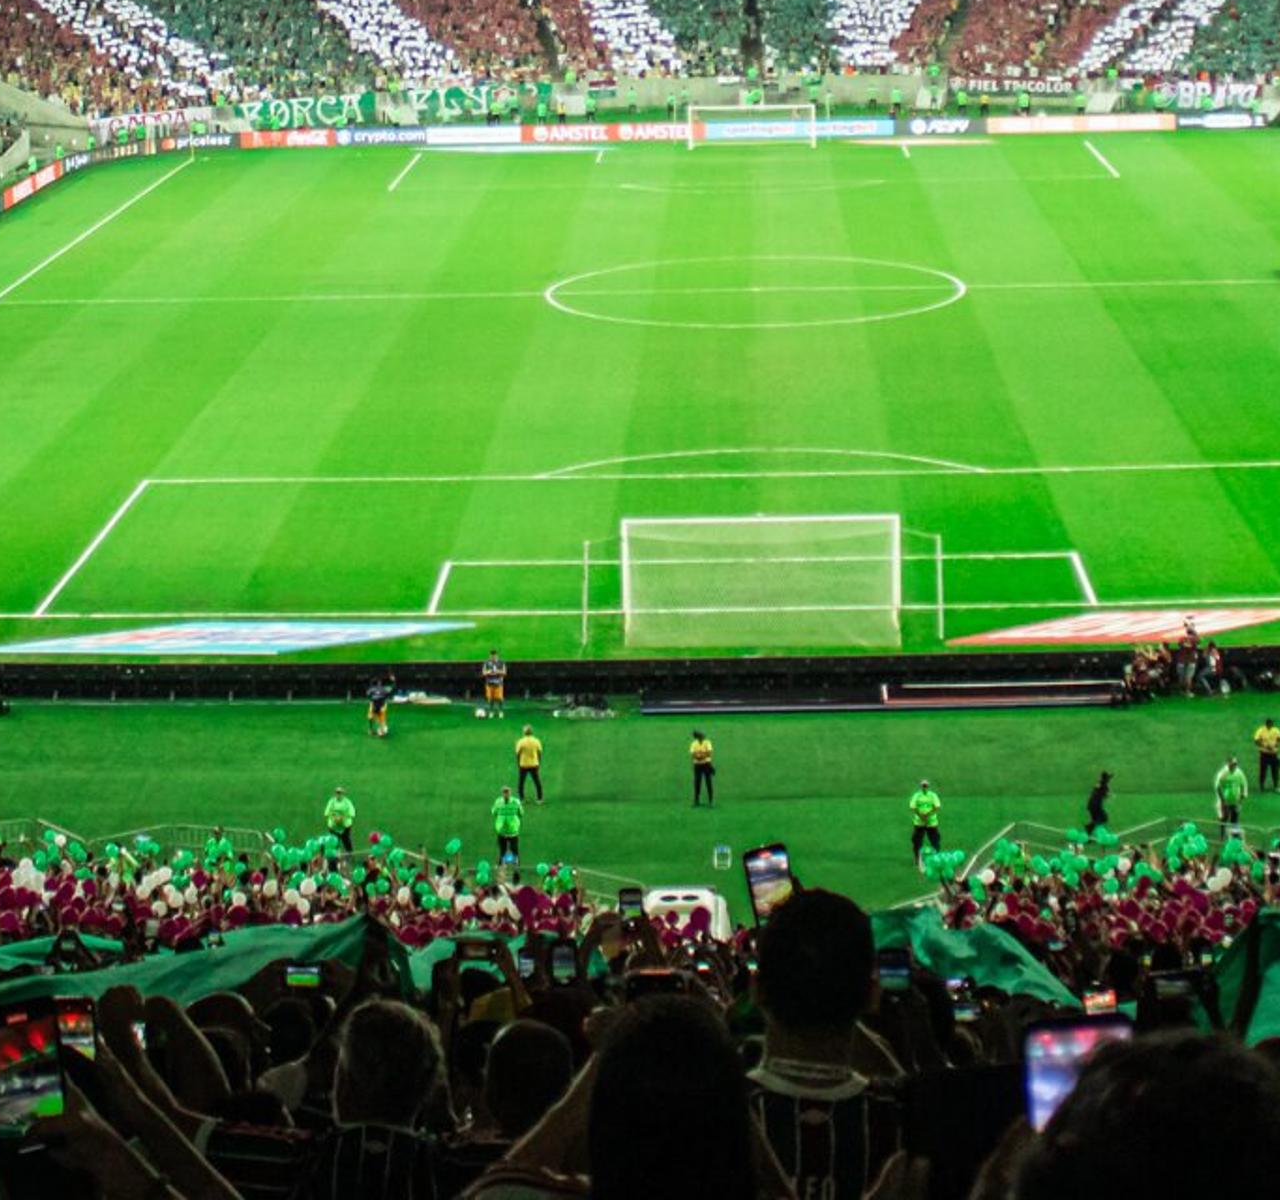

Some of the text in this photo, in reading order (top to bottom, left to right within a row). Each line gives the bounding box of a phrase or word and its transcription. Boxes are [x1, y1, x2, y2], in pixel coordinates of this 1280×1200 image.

[968, 79, 1074, 94] FIEL TRICOLOR
[353, 129, 426, 146] crypto.com
[550, 125, 609, 141] AMSTEL
